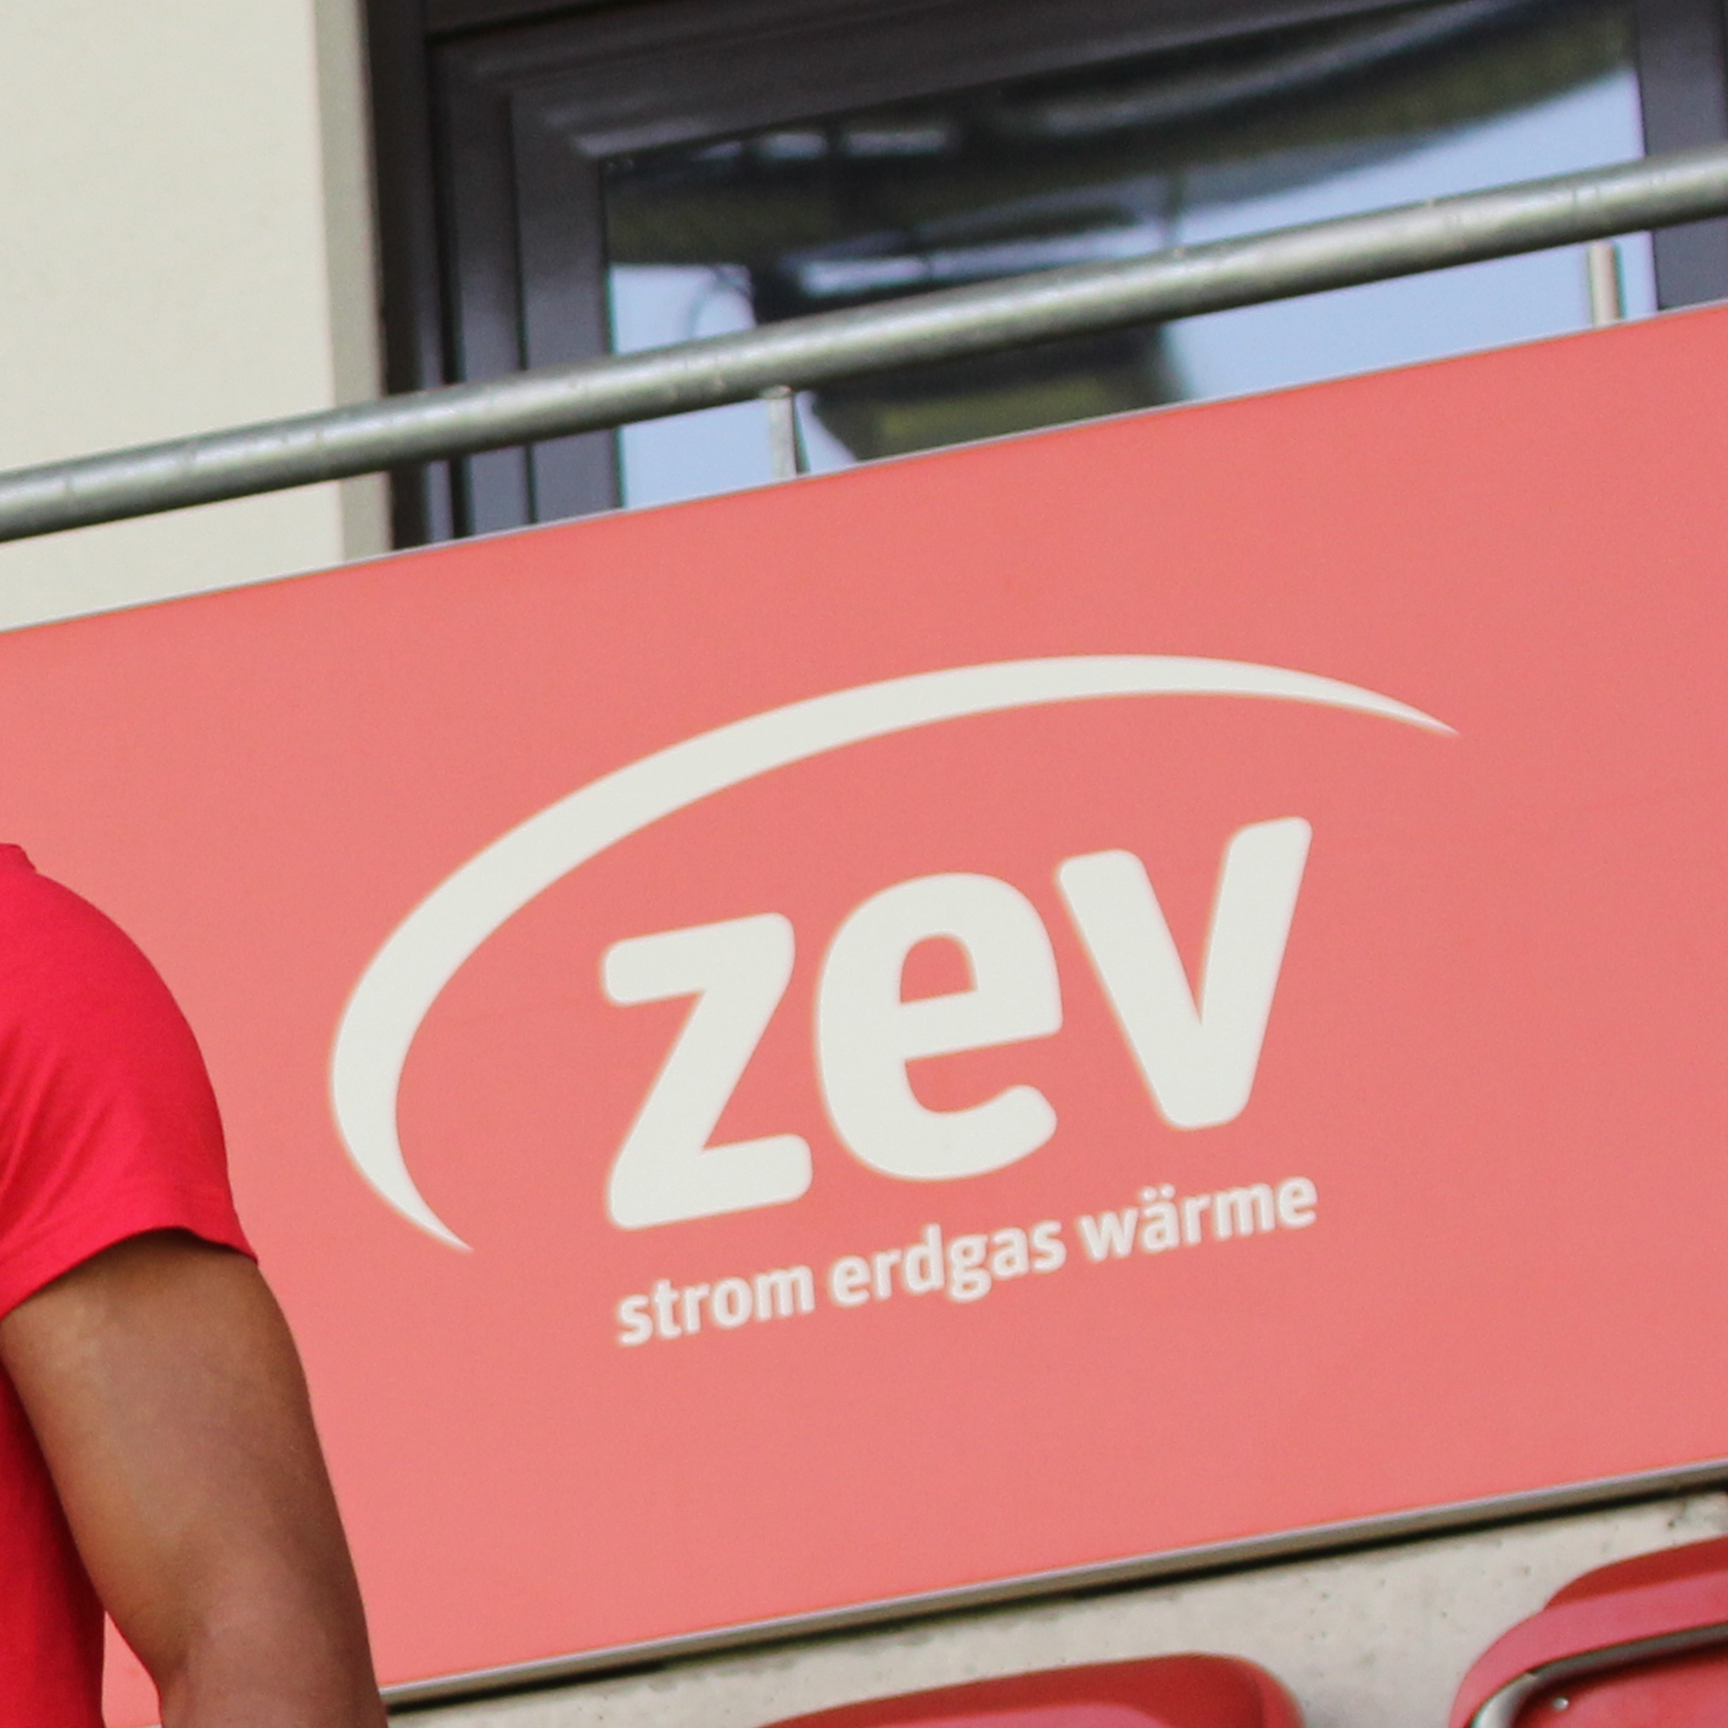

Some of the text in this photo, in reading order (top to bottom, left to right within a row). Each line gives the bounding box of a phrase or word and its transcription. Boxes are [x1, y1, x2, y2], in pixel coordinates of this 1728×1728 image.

[601, 816, 1313, 1231] zev
[617, 1176, 1319, 1347] strom erdgas wärme
